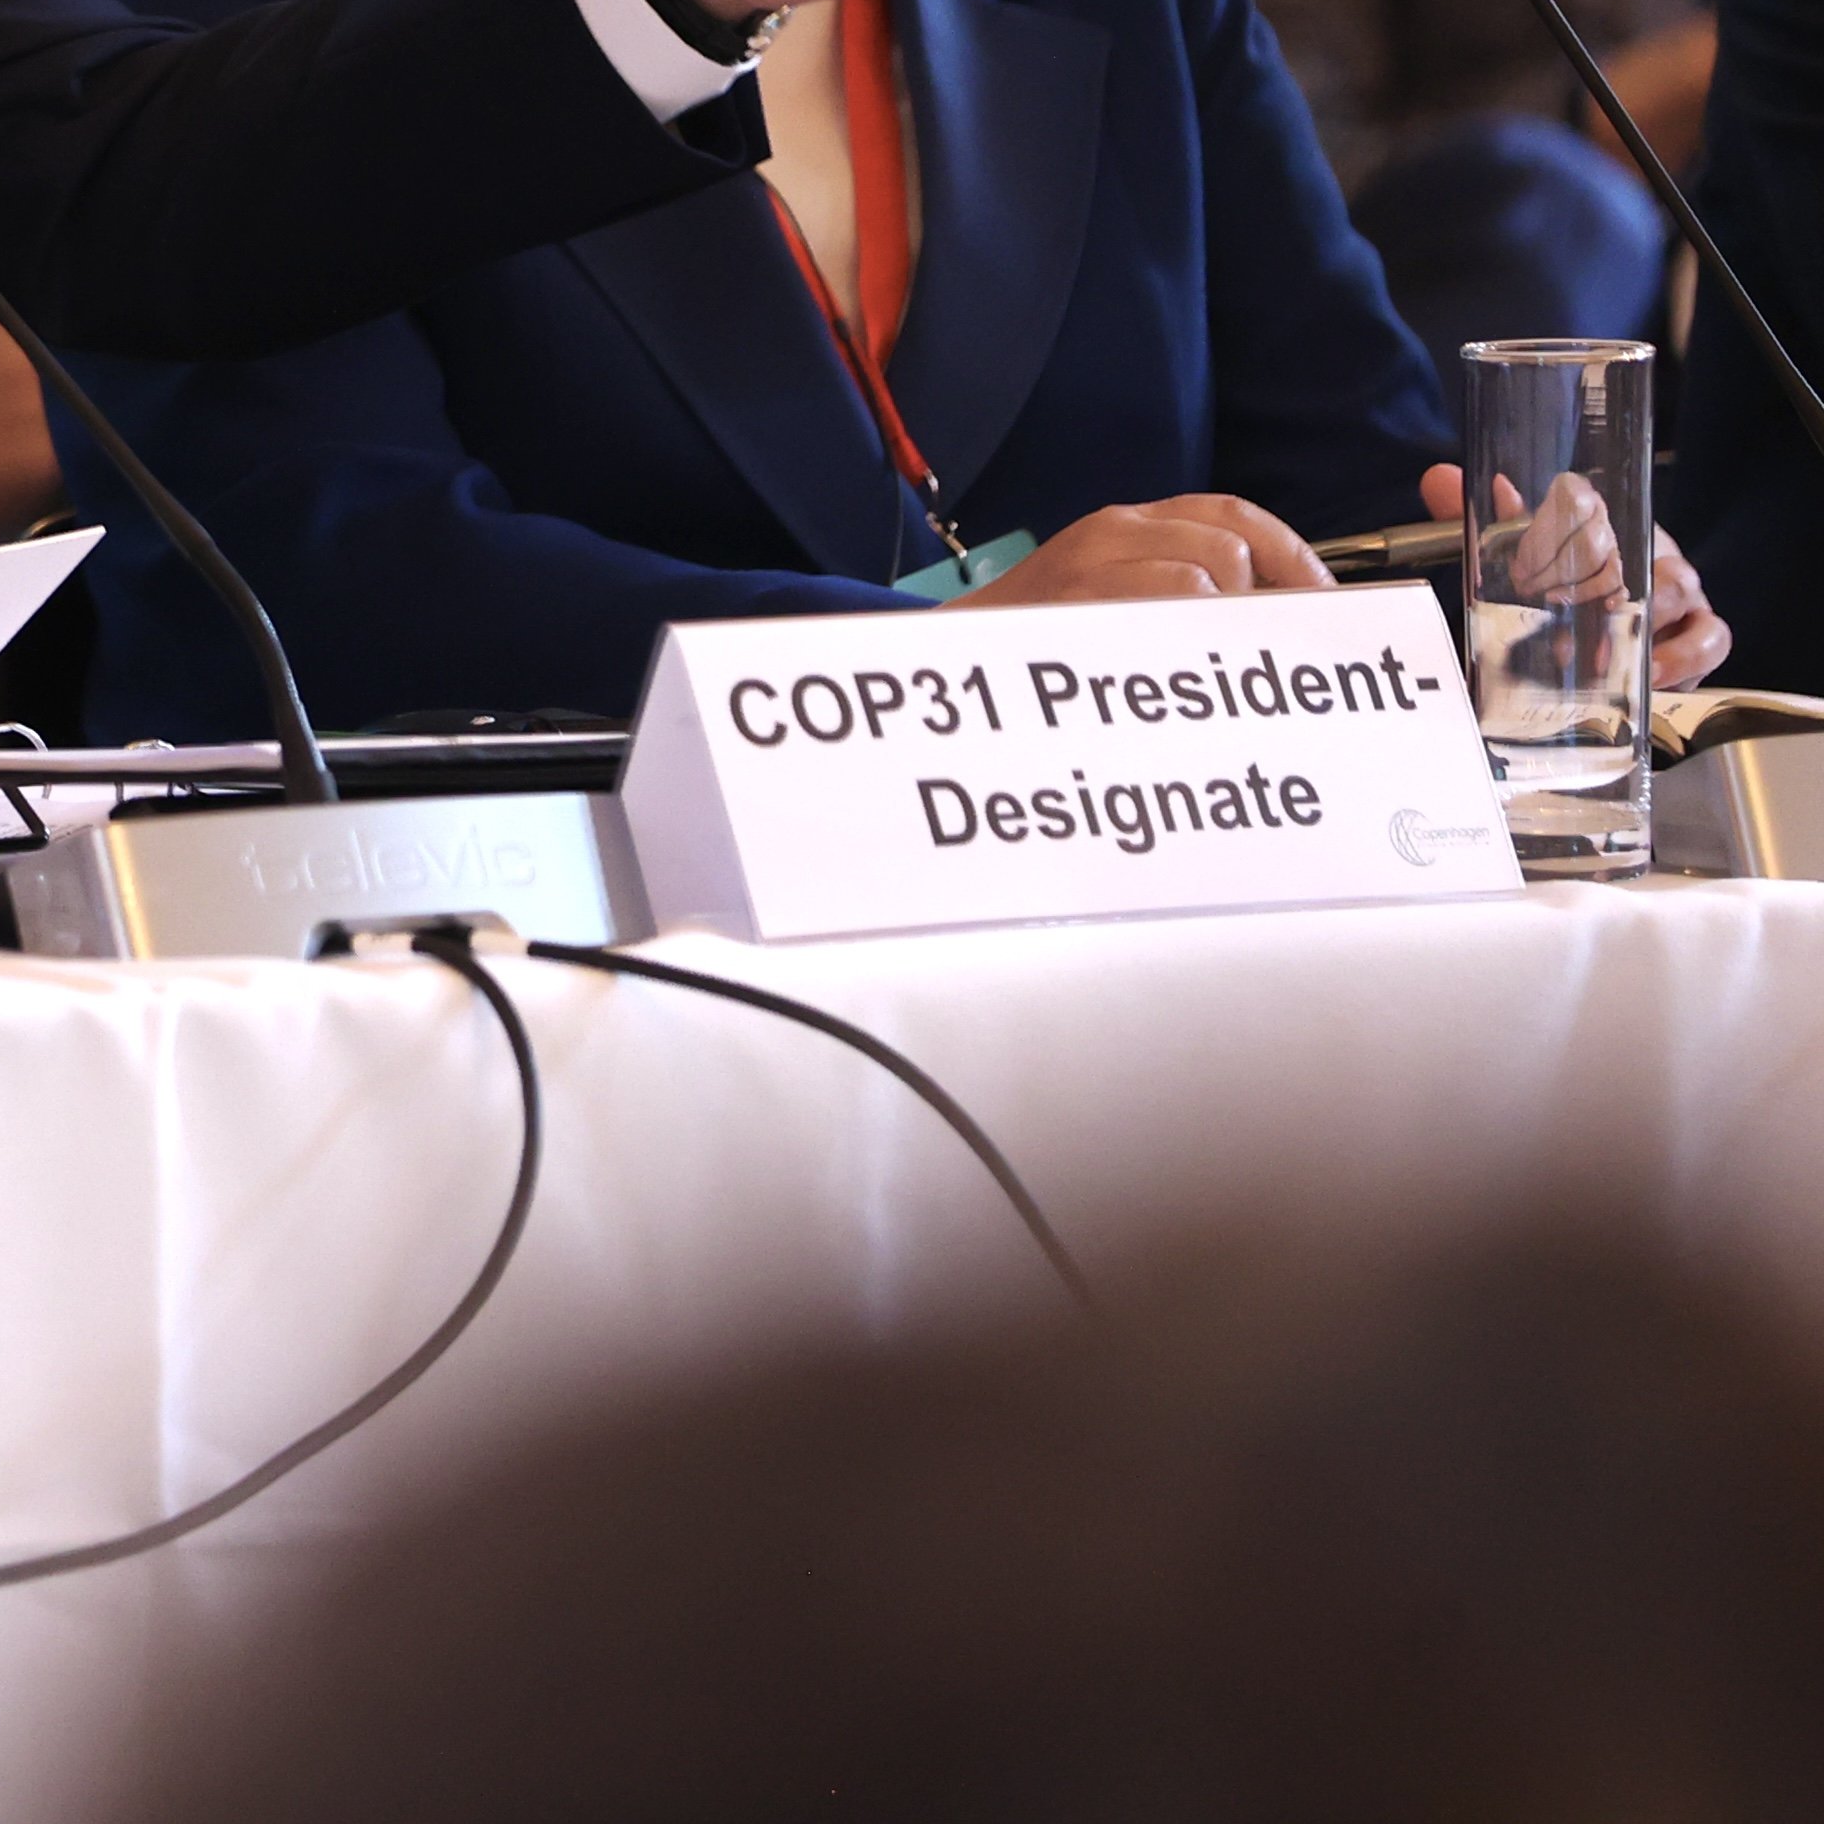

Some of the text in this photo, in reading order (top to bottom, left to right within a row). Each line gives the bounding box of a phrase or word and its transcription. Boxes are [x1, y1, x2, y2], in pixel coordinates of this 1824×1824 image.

[728, 644, 1441, 749] COP31 President-
[916, 763, 1324, 855] Designate
